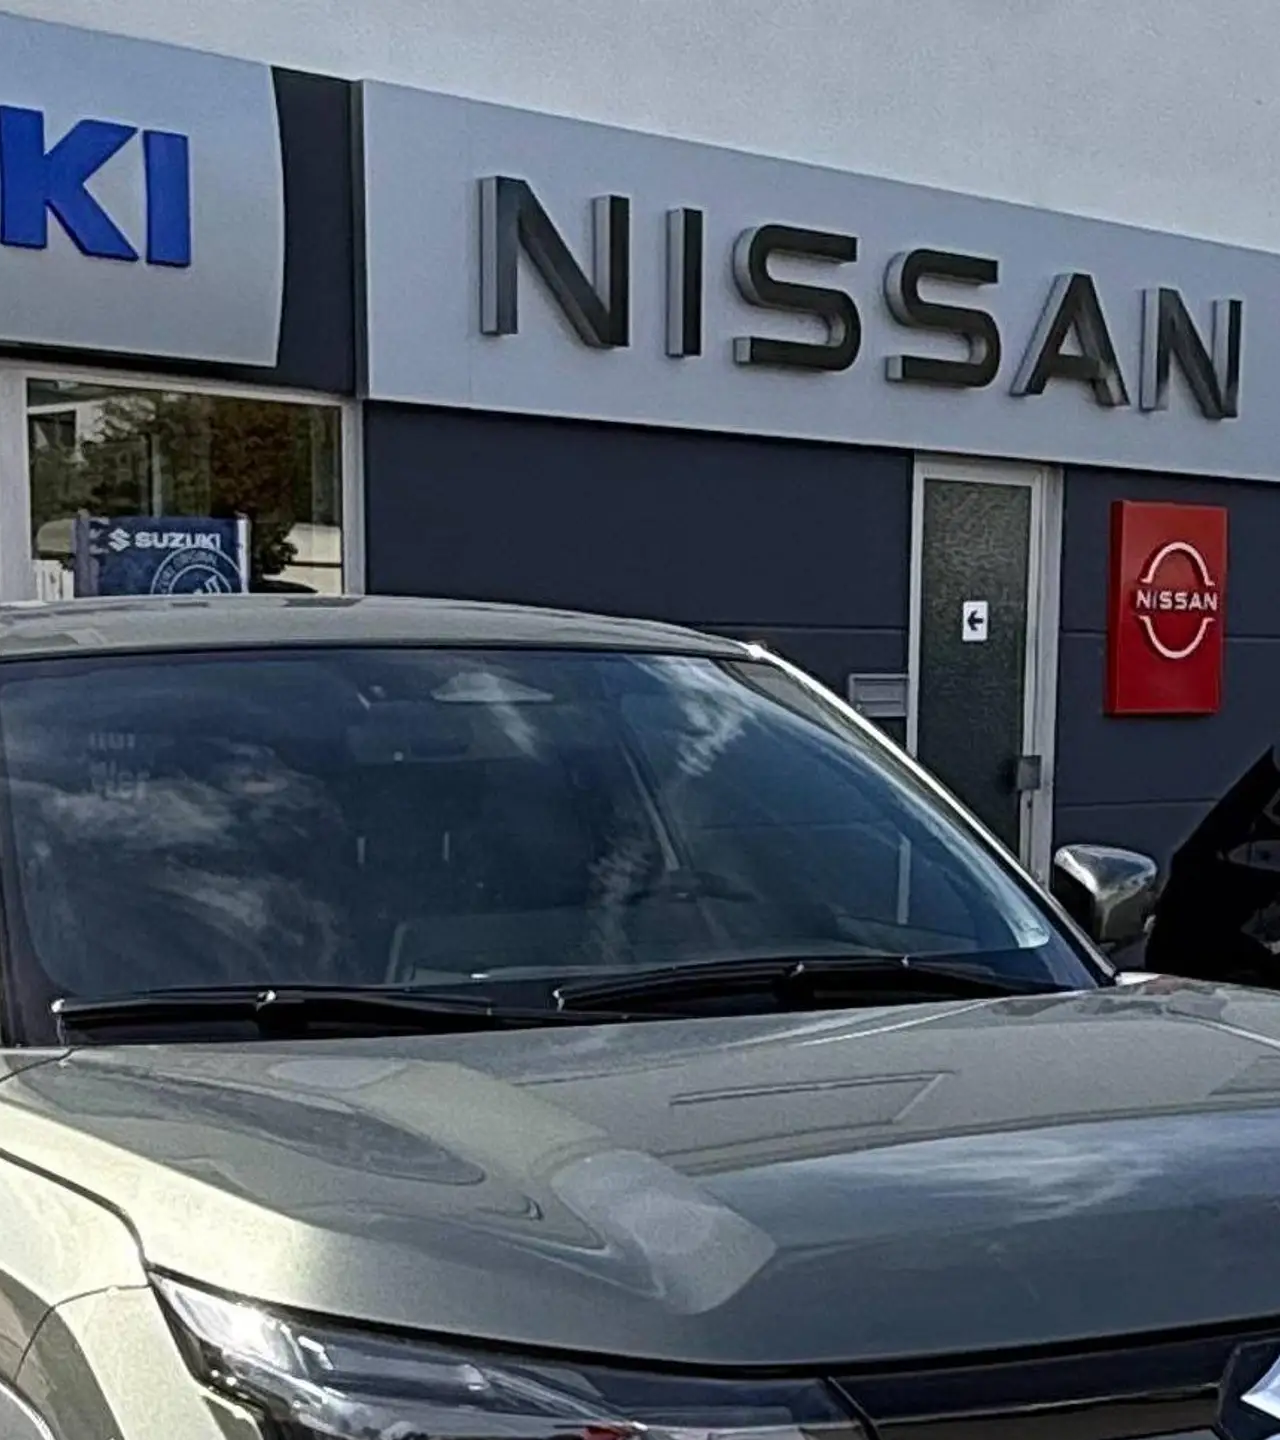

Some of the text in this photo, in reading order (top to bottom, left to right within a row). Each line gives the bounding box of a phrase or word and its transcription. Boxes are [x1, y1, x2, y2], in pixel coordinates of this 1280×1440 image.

[479, 175, 1243, 420] NISSAN
[134, 531, 222, 551] SUZUKI
[1135, 589, 1219, 611] NISSAN
